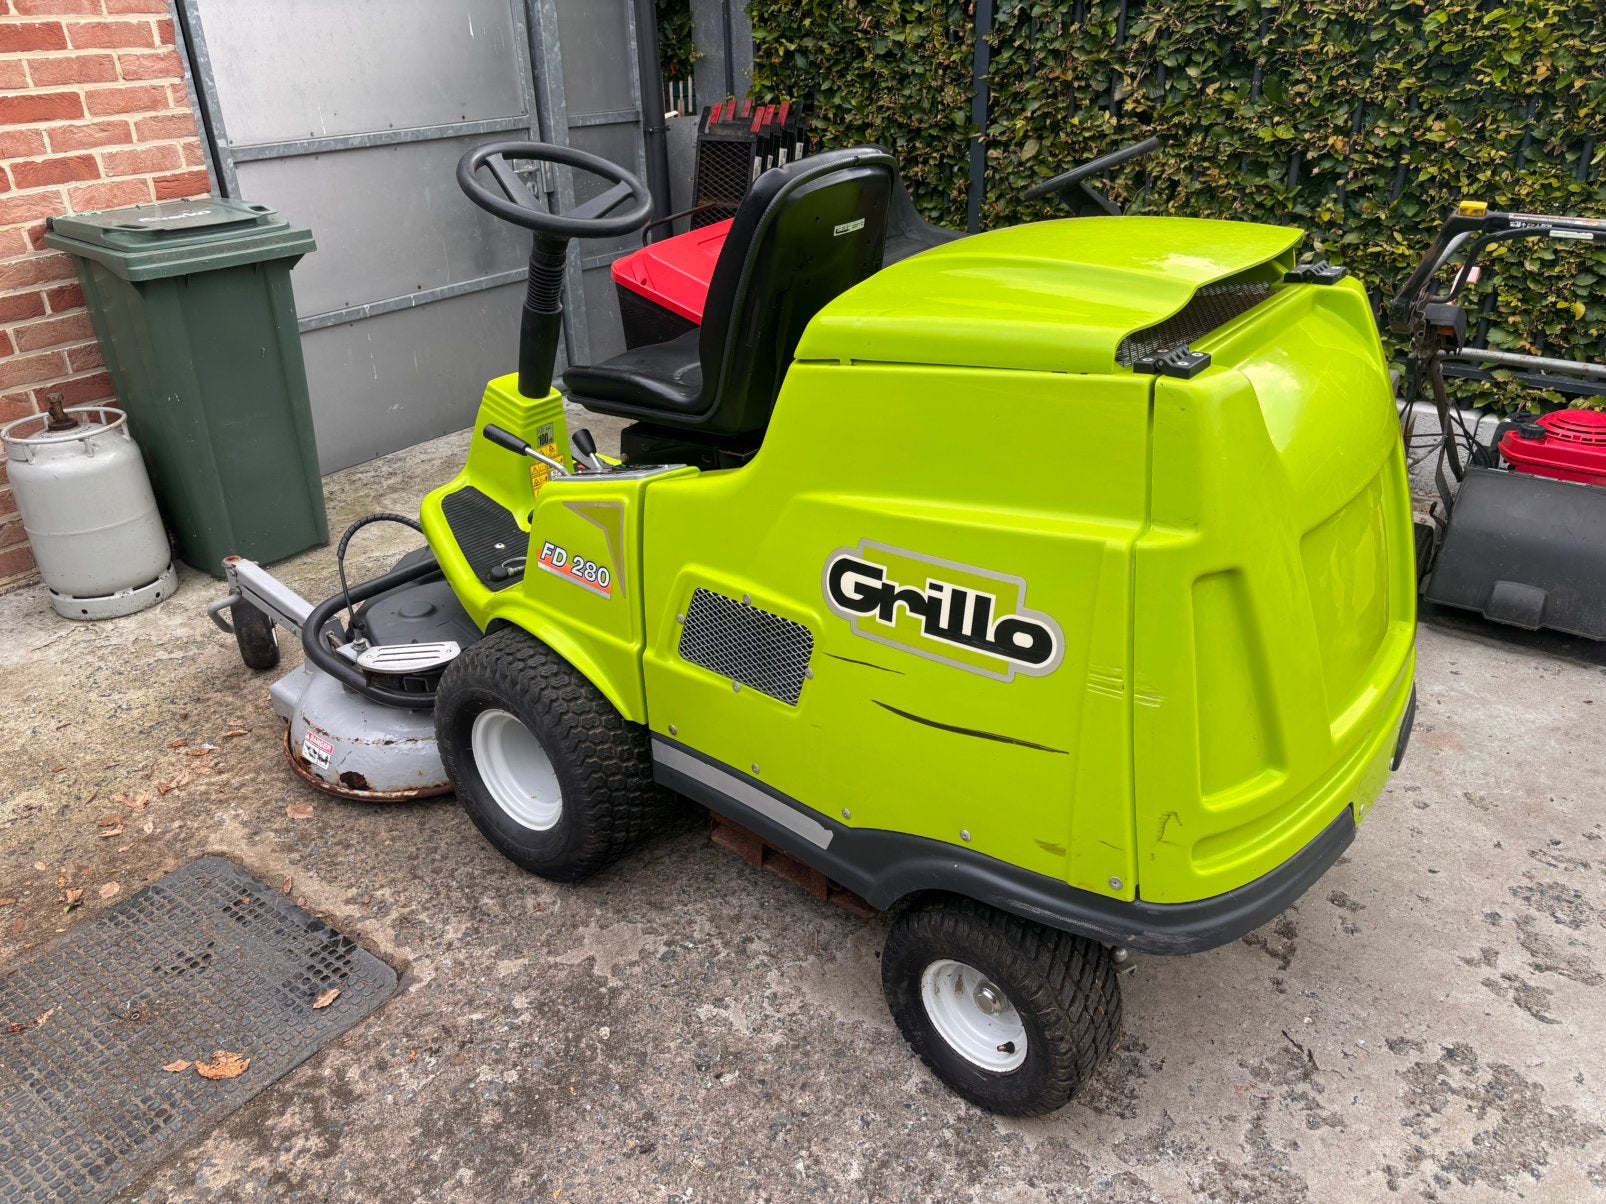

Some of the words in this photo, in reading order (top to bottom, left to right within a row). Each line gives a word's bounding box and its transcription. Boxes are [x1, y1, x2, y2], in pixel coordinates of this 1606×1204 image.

[540, 541, 568, 567] FD
[571, 556, 610, 588] 280
[827, 555, 1057, 668] Grillo
[309, 732, 331, 752] DANGER
